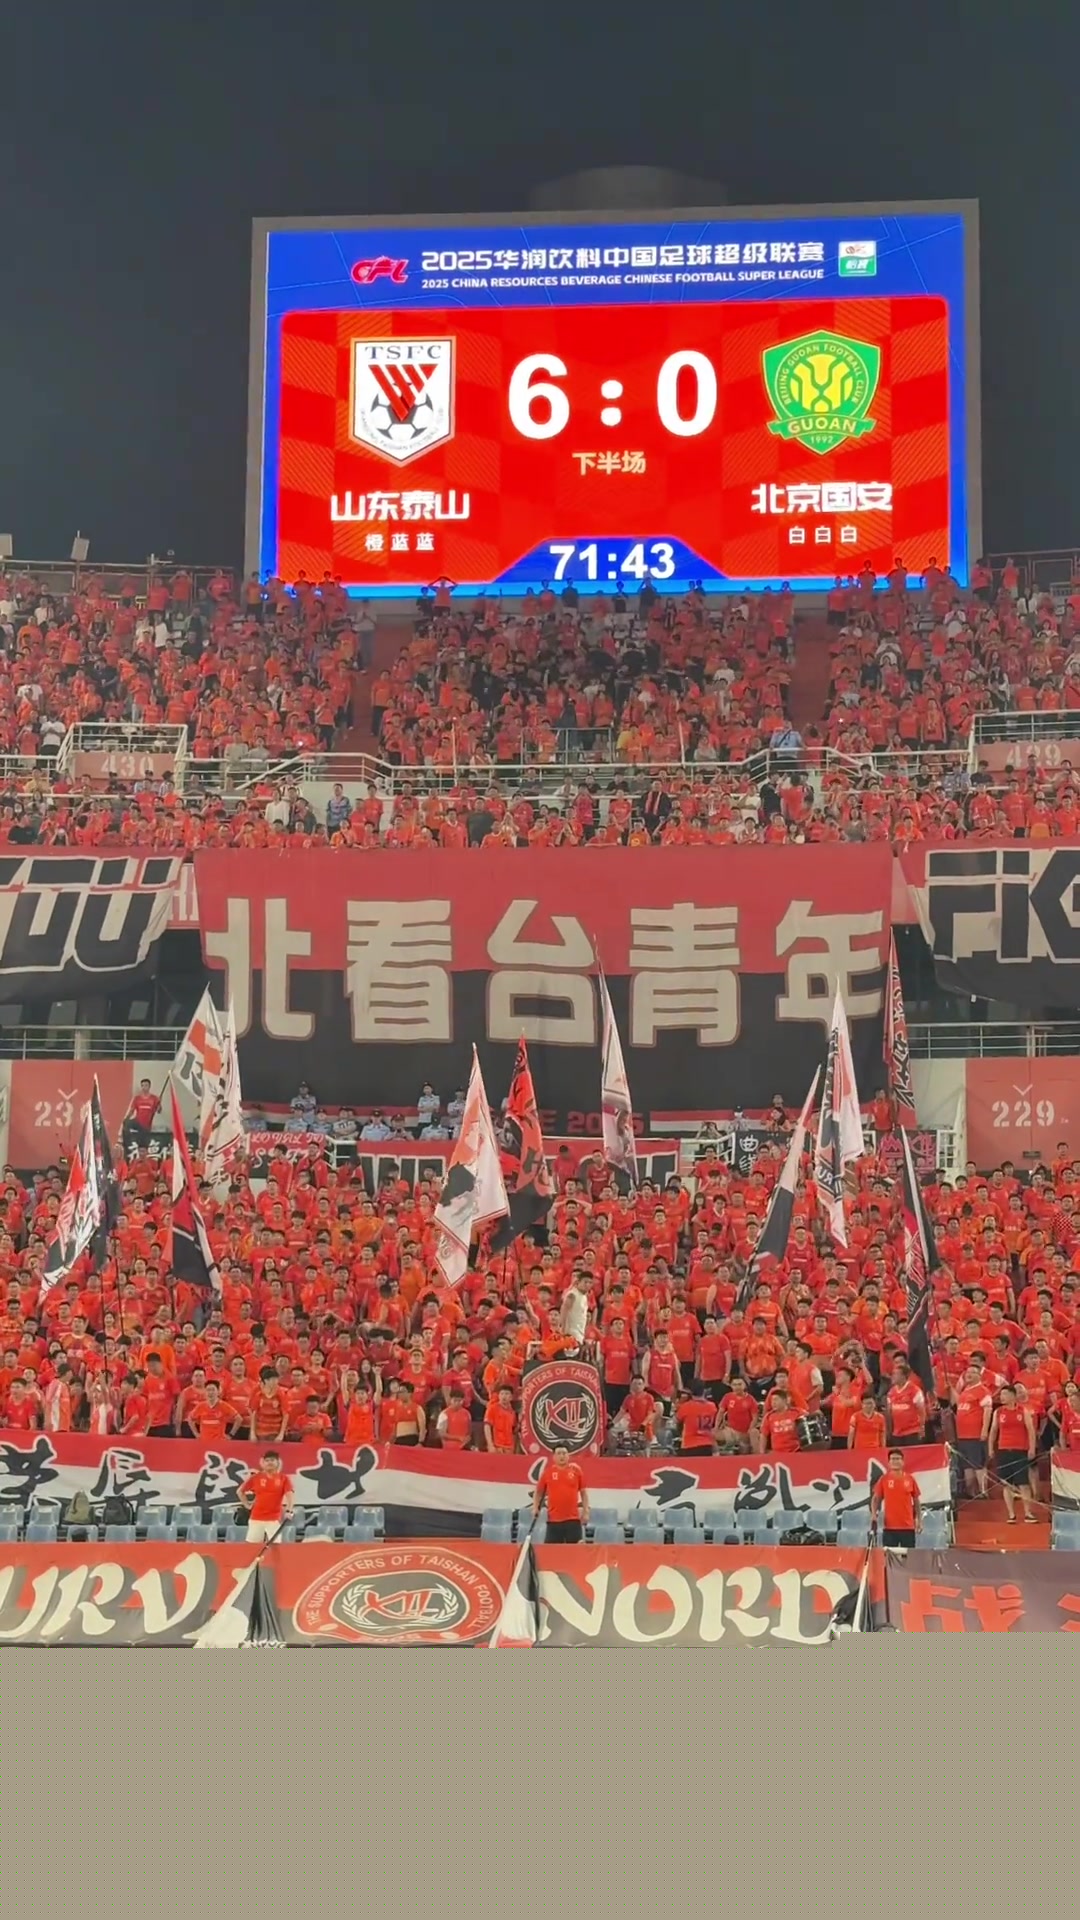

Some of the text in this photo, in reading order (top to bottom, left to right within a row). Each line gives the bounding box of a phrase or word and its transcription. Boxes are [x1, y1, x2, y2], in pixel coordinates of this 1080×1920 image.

[421, 242, 825, 271] 2025华润饮料中国足球超级联赛
[421, 269, 825, 289] 2025 CHINA RESOURCES BEVERAGE CHINESE FOOTBALL SUPER LEAGUE
[365, 345, 441, 360] TSFC
[787, 343, 820, 367] GUOAN
[823, 343, 862, 376] FOOTBALL
[509, 354, 569, 439] 6
[657, 350, 717, 437] 0
[788, 417, 857, 434] GUOAN
[811, 435, 834, 443] 1992
[572, 451, 647, 475] 下半场
[331, 490, 470, 520] 山东泰山
[751, 482, 893, 513] 北京国安
[550, 543, 675, 580] 71:43
[204, 898, 884, 1047] 北看台青年
[567, 1111, 644, 1134] 205
[992, 1100, 1054, 1127] 229
[307, 1554, 494, 1628] THE SUPPORTERS OF TAISHAN FOOTBALL
[536, 1563, 850, 1645] NORD
